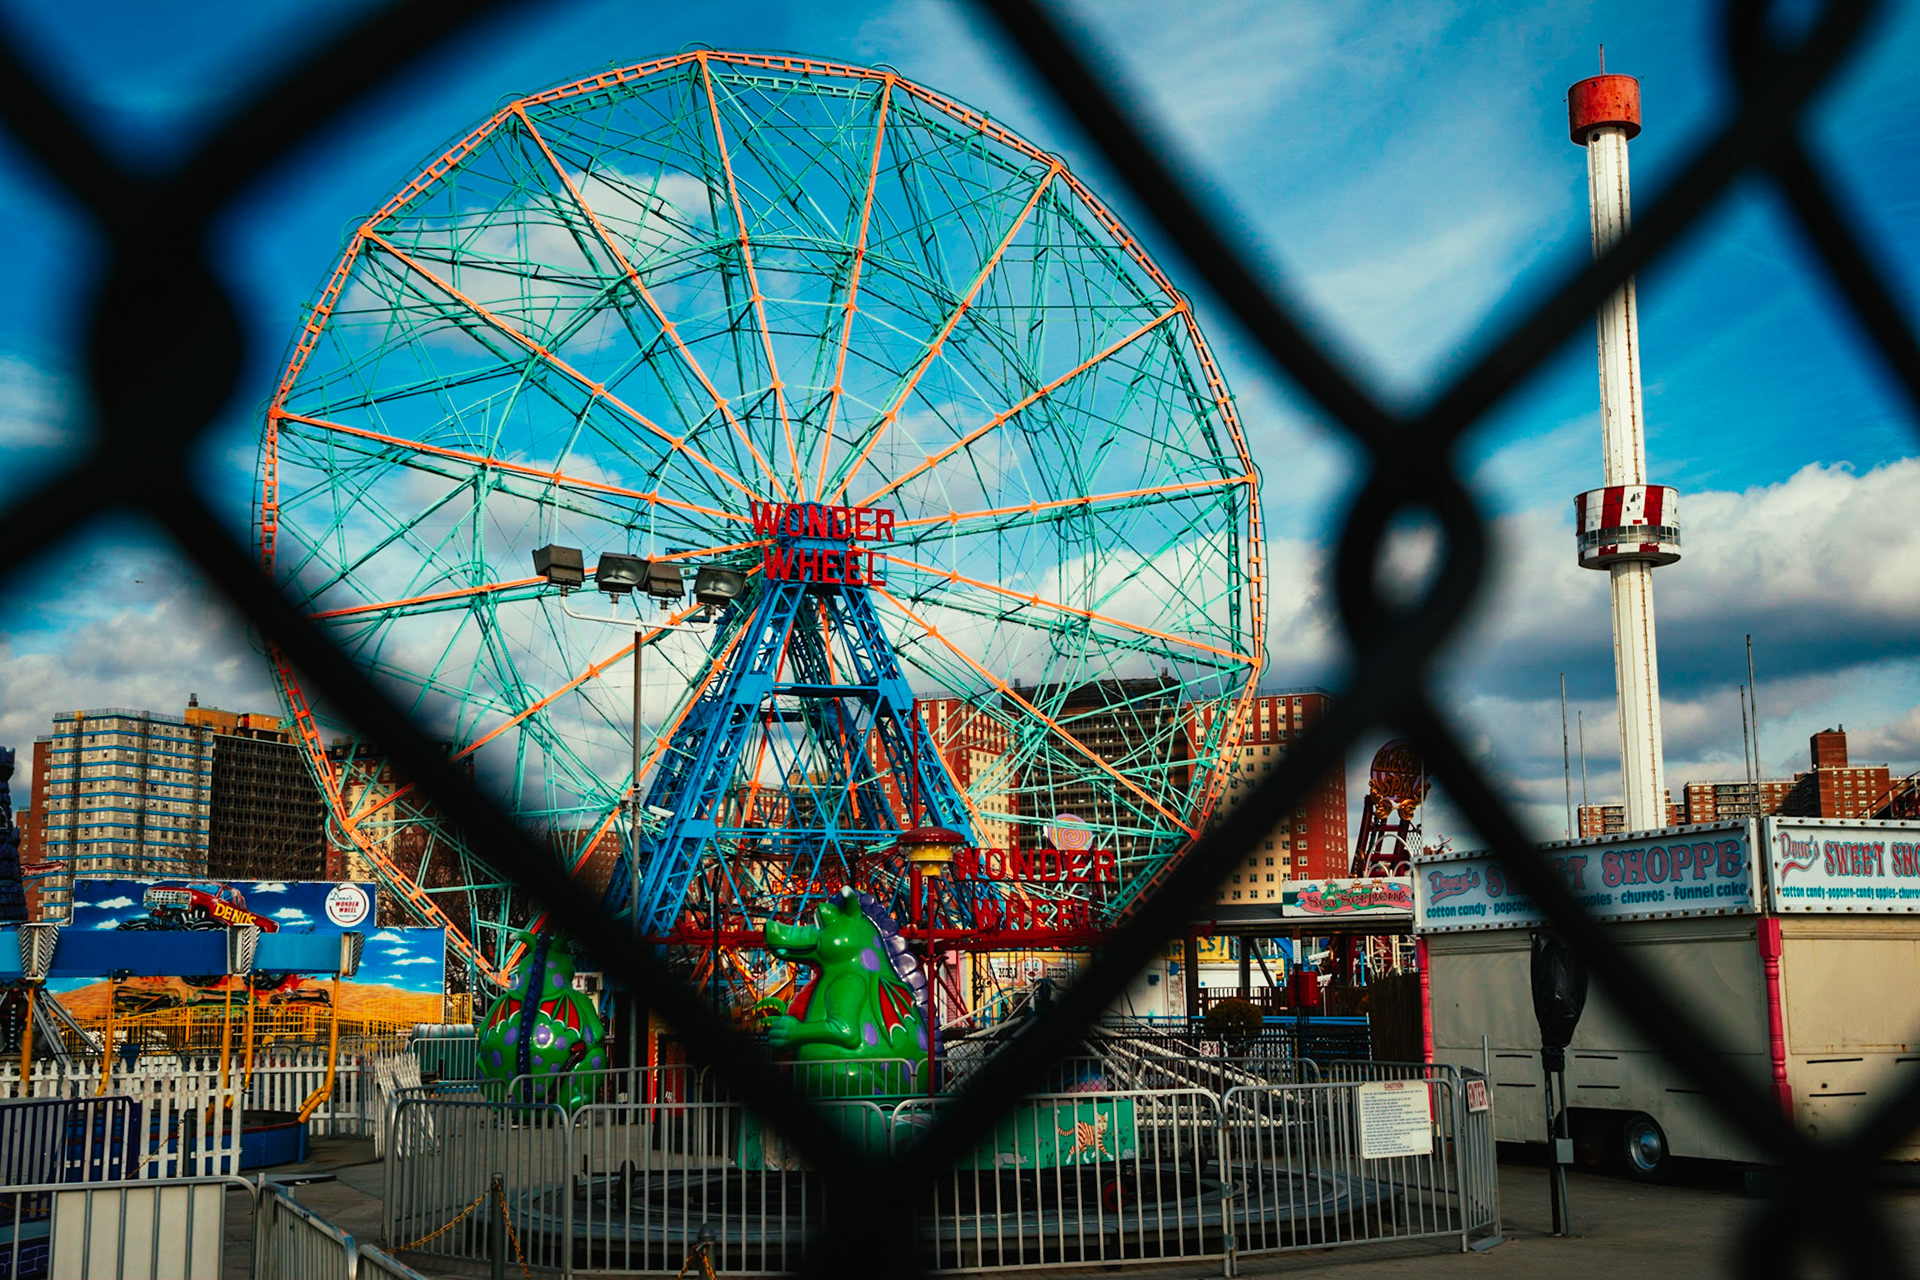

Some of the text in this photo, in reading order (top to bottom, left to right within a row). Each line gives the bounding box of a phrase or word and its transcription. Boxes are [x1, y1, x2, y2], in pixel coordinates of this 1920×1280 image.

[751, 502, 895, 542] WONDER
[763, 547, 887, 586] WHEEL
[956, 848, 1115, 882] WONDER
[1602, 839, 1743, 888] SHOPPE
[1823, 840, 1885, 877] SWEET
[1307, 890, 1407, 908] Sea Serpent
[1426, 906, 1456, 918] cotton
[1458, 902, 1486, 917] candy
[1621, 889, 1664, 904] churros
[1673, 884, 1713, 900] funnel
[1782, 887, 1804, 898] cotton
[1806, 886, 1826, 900] candy
[213, 902, 257, 925] DENO'S
[1201, 1042, 1227, 1055] EXI
[1384, 1082, 1404, 1090] CAUTION
[1468, 1080, 1487, 1109] ENTER
